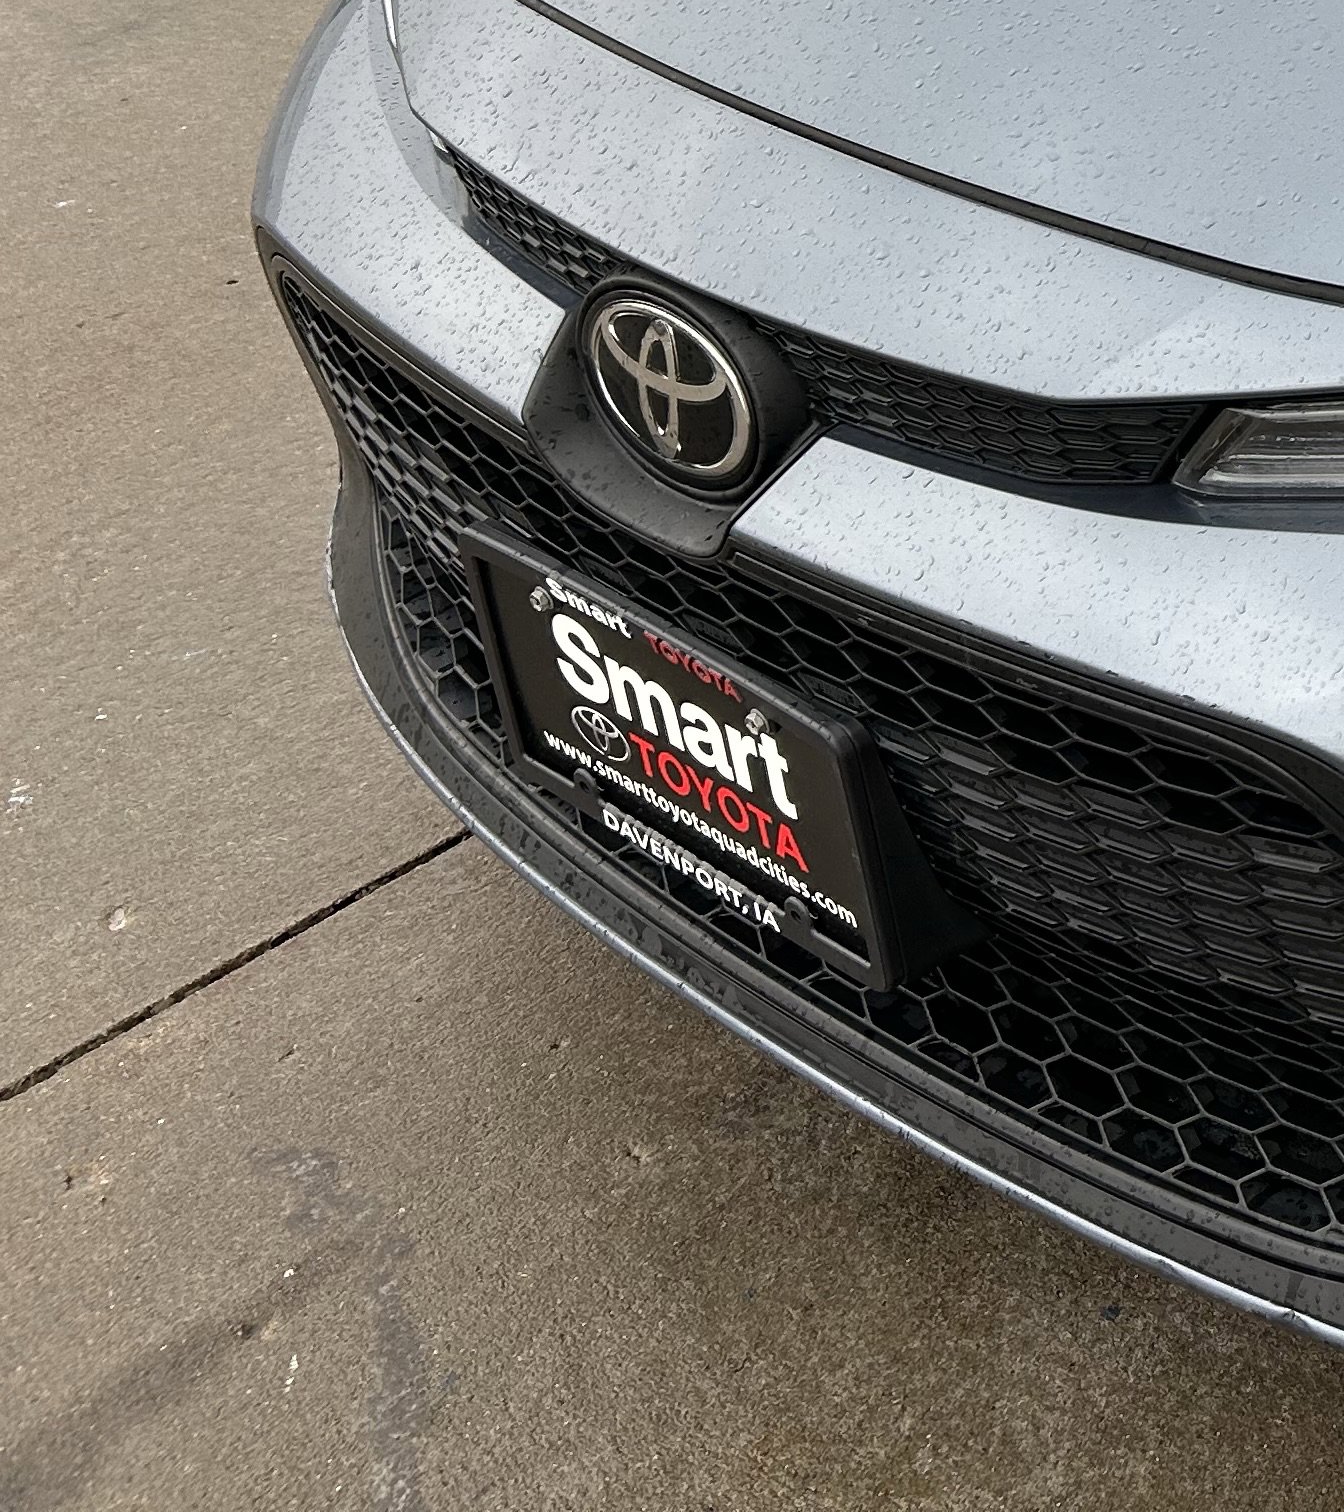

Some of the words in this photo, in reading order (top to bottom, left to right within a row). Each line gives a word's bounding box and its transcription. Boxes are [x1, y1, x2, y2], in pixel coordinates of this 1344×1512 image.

[545, 577, 633, 639] Smart
[643, 630, 743, 703] TOYOTA
[551, 613, 799, 820] Smart
[543, 730, 858, 930] www.smarttoyotaquadcities.com
[601, 808, 751, 917] DAVENPORT,
[753, 895, 781, 934] IA
[628, 732, 810, 874] TOYOTA
